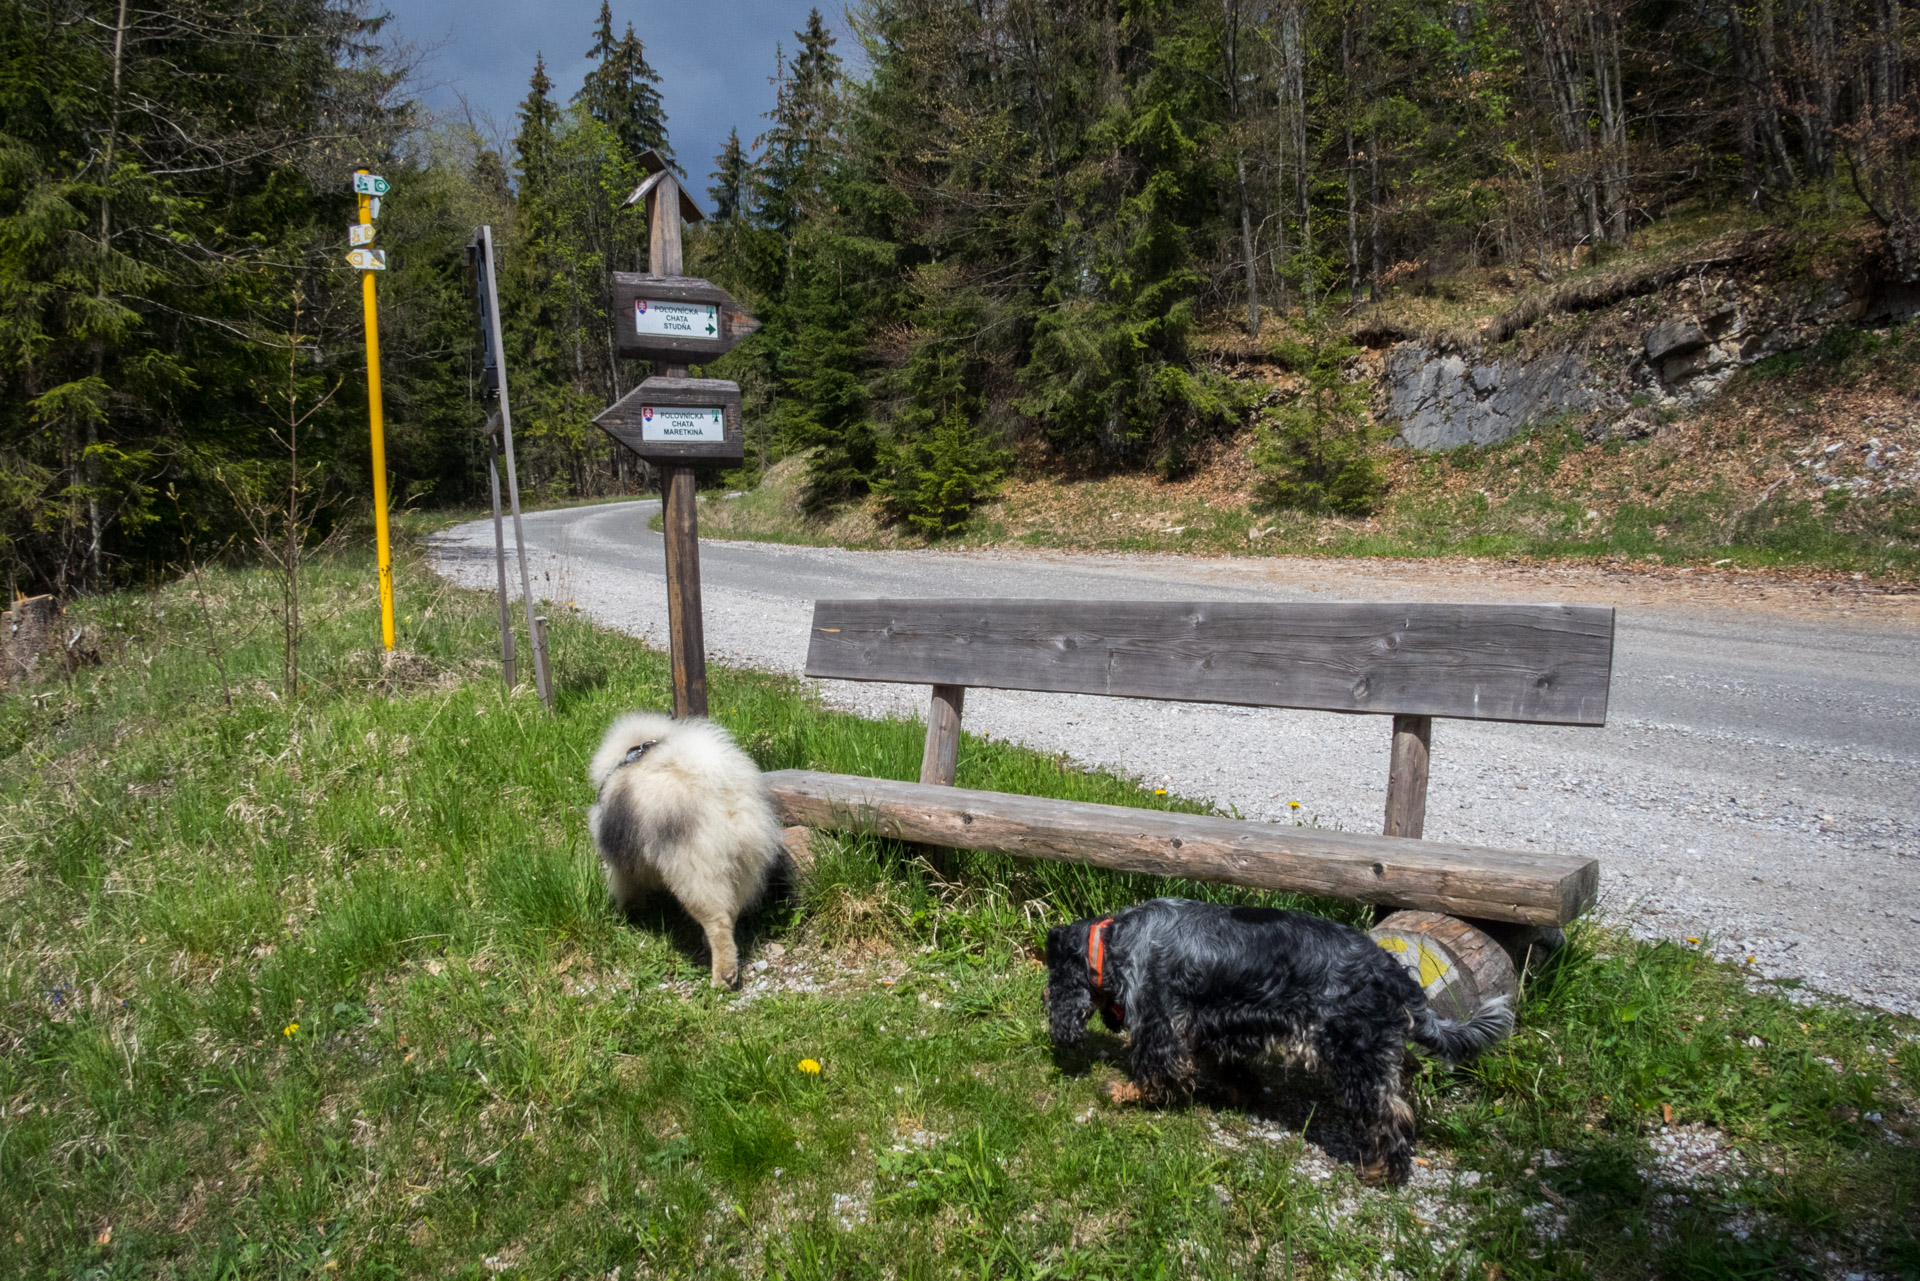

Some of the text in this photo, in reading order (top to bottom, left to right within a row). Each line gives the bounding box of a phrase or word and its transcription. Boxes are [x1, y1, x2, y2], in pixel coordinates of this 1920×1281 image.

[666, 314, 689, 322] CHATA
[663, 321, 692, 331] STUDŇA
[671, 420, 695, 428] CHATA
[663, 427, 704, 436] MARETKINÁ
